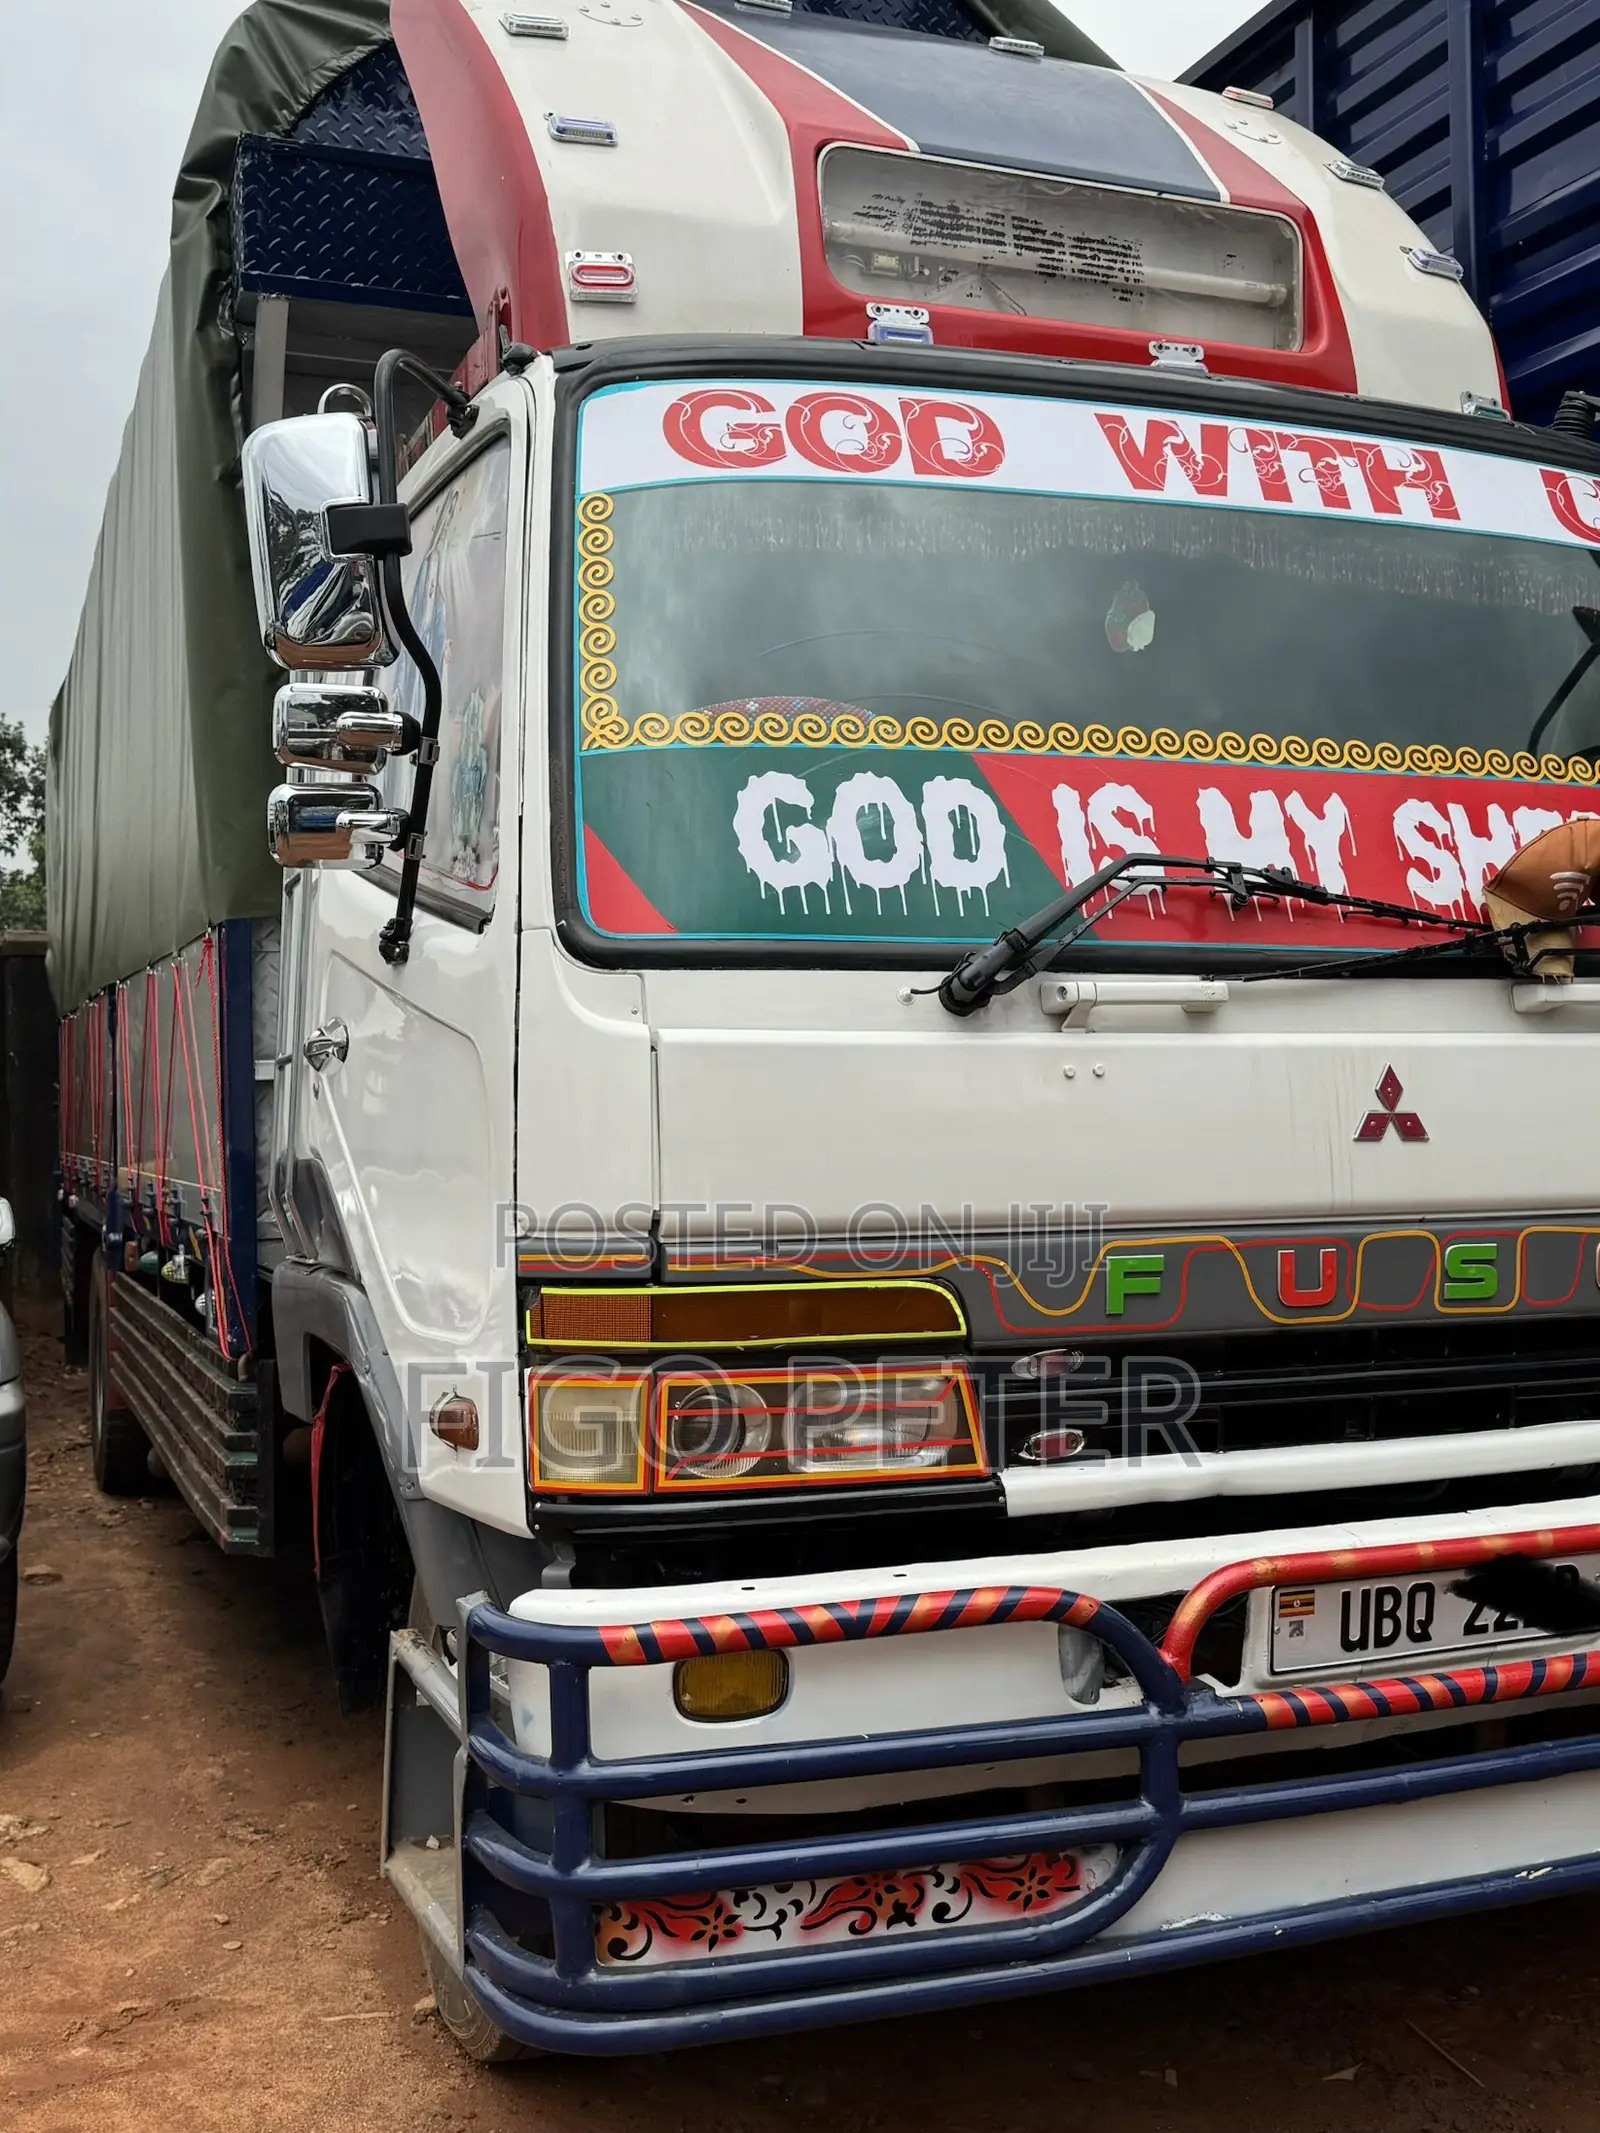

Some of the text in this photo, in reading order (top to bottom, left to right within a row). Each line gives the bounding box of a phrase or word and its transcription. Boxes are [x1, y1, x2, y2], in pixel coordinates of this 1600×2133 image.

[662, 388, 1005, 477] GOD
[1094, 412, 1461, 520] WITH
[733, 771, 1010, 917] GOD
[1051, 782, 1167, 920] IS
[1196, 786, 1357, 923] MY
[1340, 1581, 1436, 1652] UBQ
